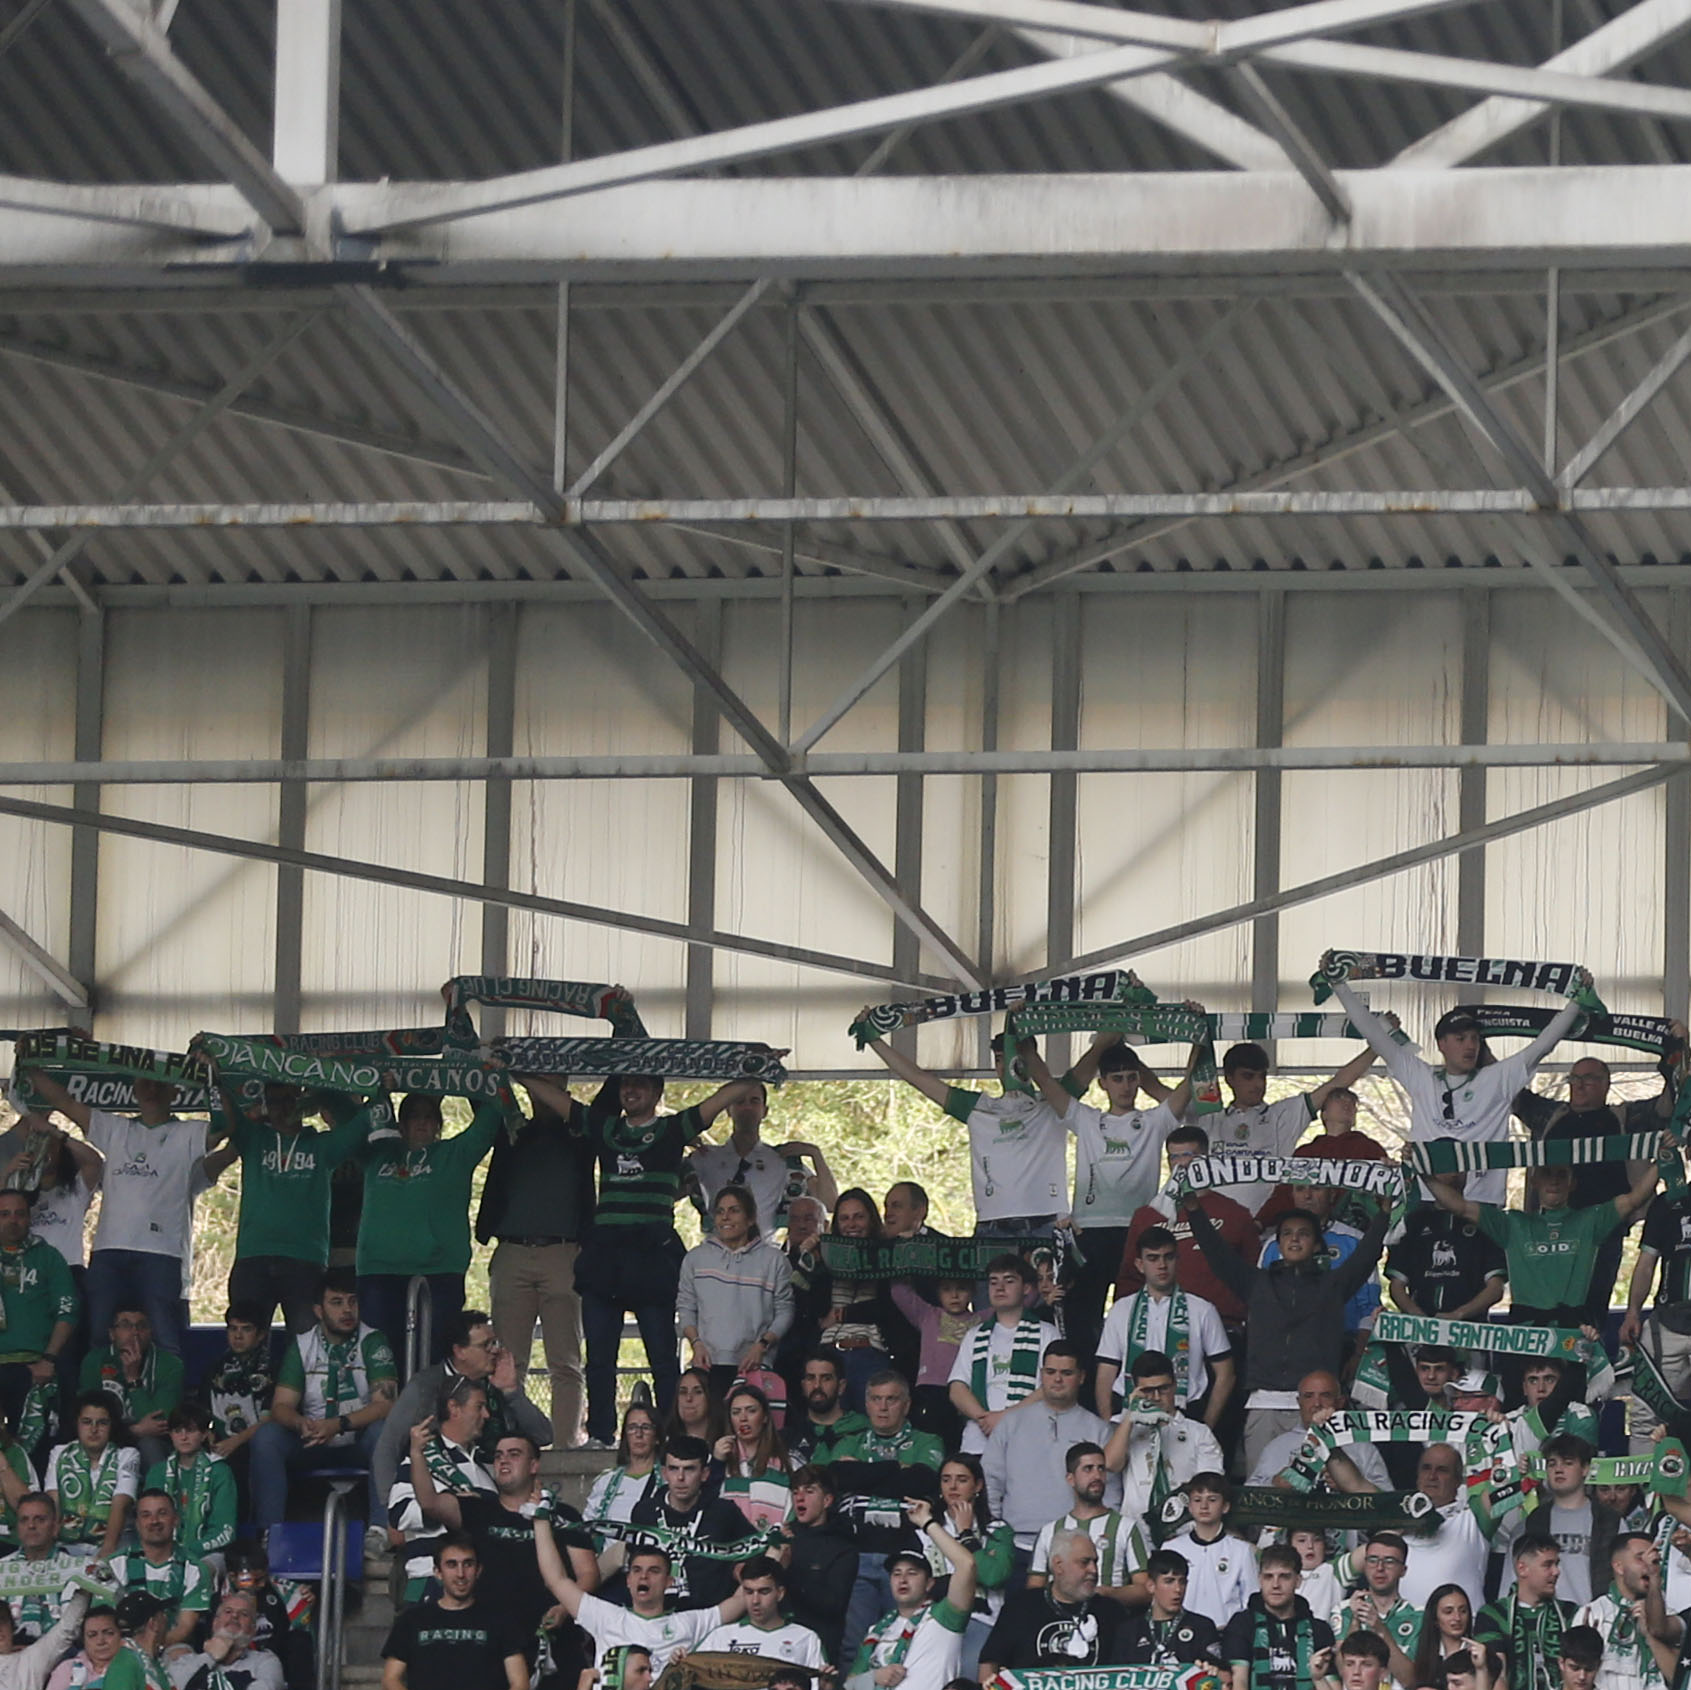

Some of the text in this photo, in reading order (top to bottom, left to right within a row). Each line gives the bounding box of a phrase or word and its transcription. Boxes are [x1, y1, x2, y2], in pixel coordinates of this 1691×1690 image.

[1376, 954, 1574, 996] BUELNA
[518, 979, 594, 1002] RACING
[1612, 1015, 1647, 1032] VALLE
[1612, 1027, 1664, 1045] BUELNA
[67, 1041, 156, 1073] DE UNA
[1188, 1157, 1286, 1188] ONDO
[1378, 1314, 1549, 1356] RACING SANTANDER
[1320, 1412, 1505, 1445] REAL RACING CLU
[1614, 1459, 1652, 1478] RAC
[419, 1629, 487, 1642] RACING
[1115, 1671, 1175, 1690] CLUB
